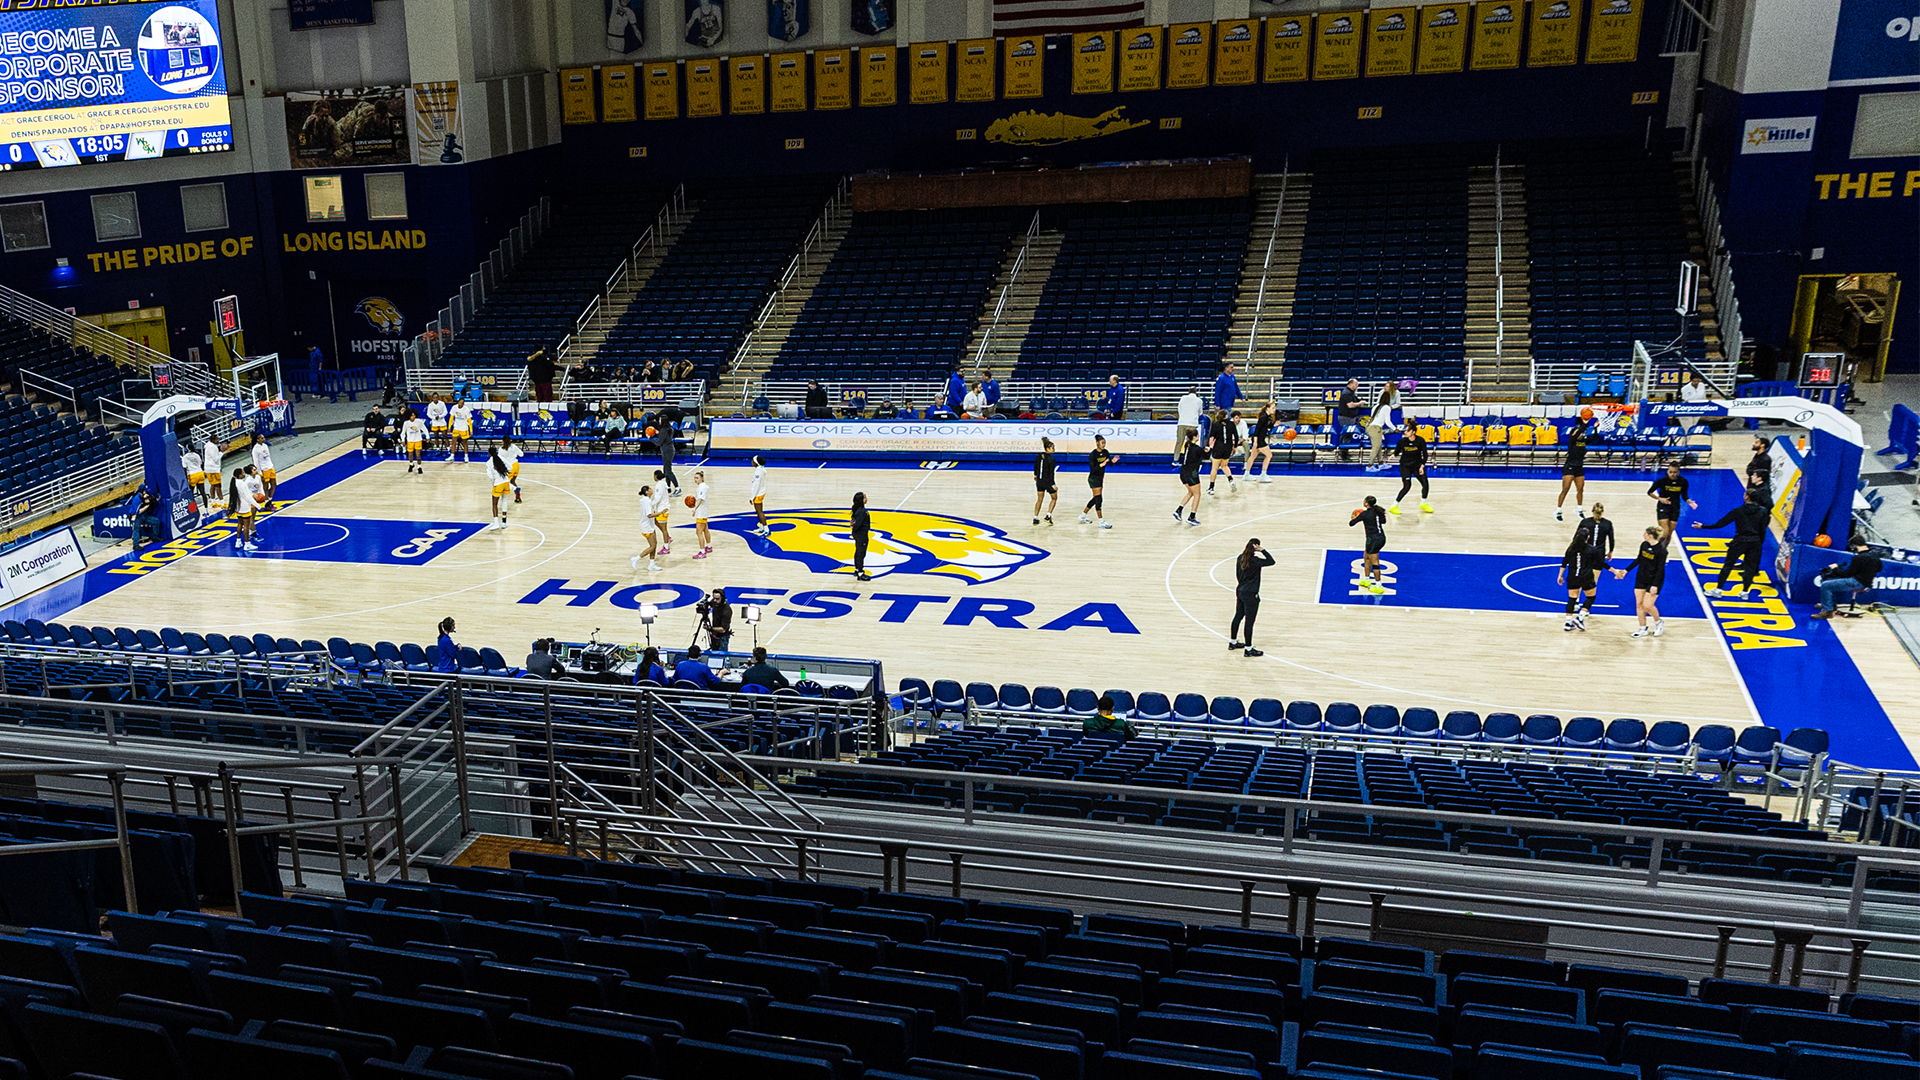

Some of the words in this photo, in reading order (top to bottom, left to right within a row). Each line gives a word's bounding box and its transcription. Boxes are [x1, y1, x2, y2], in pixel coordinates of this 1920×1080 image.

[1544, 24, 1567, 32] NIT
[1604, 19, 1628, 28] NIT
[1432, 31, 1455, 39] NIT
[1484, 27, 1513, 36] WNIT
[0, 27, 97, 55] ECOME
[100, 26, 120, 48] A
[1325, 38, 1353, 46] WNIT
[1378, 34, 1406, 42] WNIT
[1222, 45, 1252, 54] WNIT
[1274, 41, 1301, 50] WNIT
[0, 49, 134, 80] ORPORATE
[820, 67, 845, 75] AIAW
[17, 115, 42, 124] GRACE
[44, 113, 75, 122] CERGOL
[87, 102, 210, 118] GRACE.R.CERGOL@HOFSTRA.EDU
[10, 130, 40, 138] DENNIS
[42, 126, 88, 136] PAPADATOS
[100, 118, 184, 131] DPAPA@HOFSTRA.EDU
[176, 130, 189, 147] 0
[1768, 128, 1811, 141] Hillel
[9, 144, 22, 162] 0
[77, 135, 124, 153] 18:05
[94, 154, 108, 162] 1ST
[1814, 171, 1896, 200] THE
[284, 231, 344, 254] LONG
[347, 229, 427, 252] ISLAND
[87, 249, 139, 274] THE
[143, 240, 217, 268] PRIDE
[221, 235, 254, 258] OF
[222, 311, 235, 330] 30
[158, 375, 168, 385] 30
[476, 376, 495, 386] 108
[1660, 372, 1691, 384] 113
[1809, 368, 1831, 382] 30
[643, 390, 664, 400] 109
[843, 390, 864, 400] 110
[1084, 390, 1107, 400] 111
[1325, 390, 1341, 401] 11
[230, 420, 242, 430] 107
[764, 425, 854, 435] BECOME
[858, 426, 872, 434] A
[877, 426, 1012, 436] CORPORATE
[1018, 426, 1138, 437] SPONSOR!
[12, 500, 30, 516] 106
[172, 498, 188, 512] Apple
[173, 509, 189, 521] Bank
[391, 528, 462, 558] CAA
[8, 564, 22, 578] 2M
[22, 544, 74, 568] Corporation
[516, 578, 1141, 635] HOFSTRA
